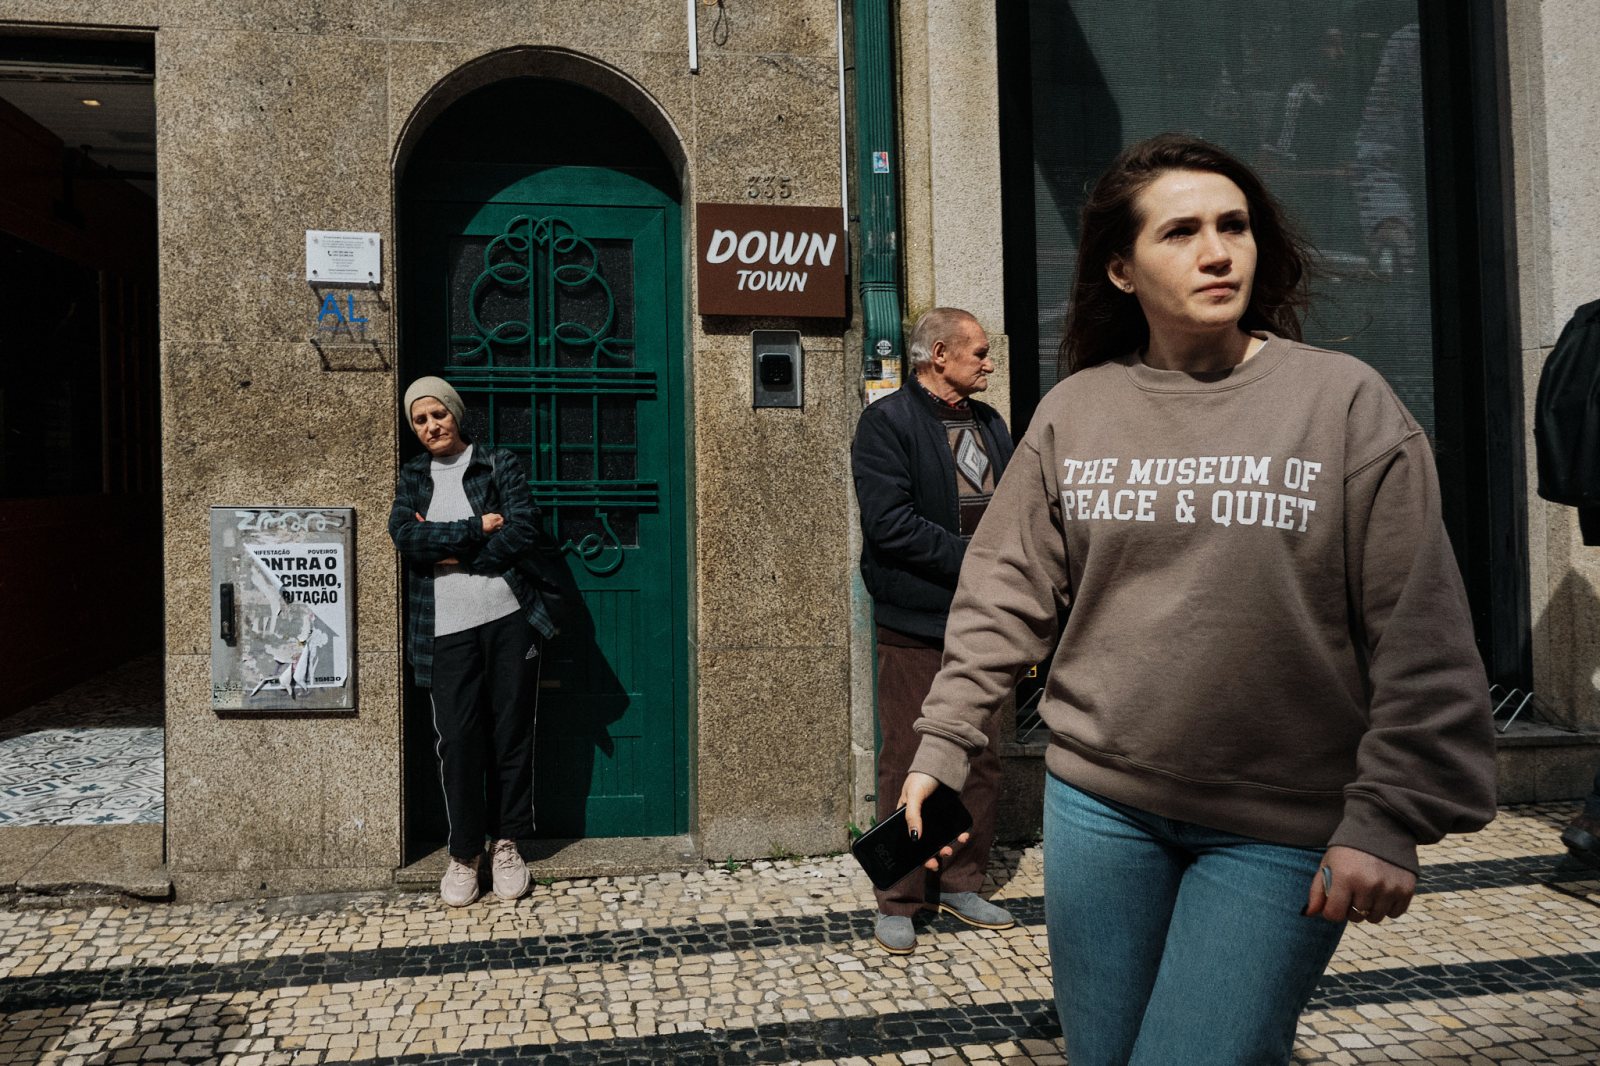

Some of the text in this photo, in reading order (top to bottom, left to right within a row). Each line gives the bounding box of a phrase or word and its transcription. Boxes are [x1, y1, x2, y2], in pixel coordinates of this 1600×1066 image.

[747, 175, 792, 199] 335
[706, 229, 837, 266] DOWN
[736, 270, 808, 292] TOWN
[318, 293, 369, 323] AL
[1063, 455, 1322, 492] THE MUSEUM OF
[1061, 489, 1316, 533] PEACE & QUIET
[324, 556, 337, 570] O
[275, 573, 342, 589] CISMO,
